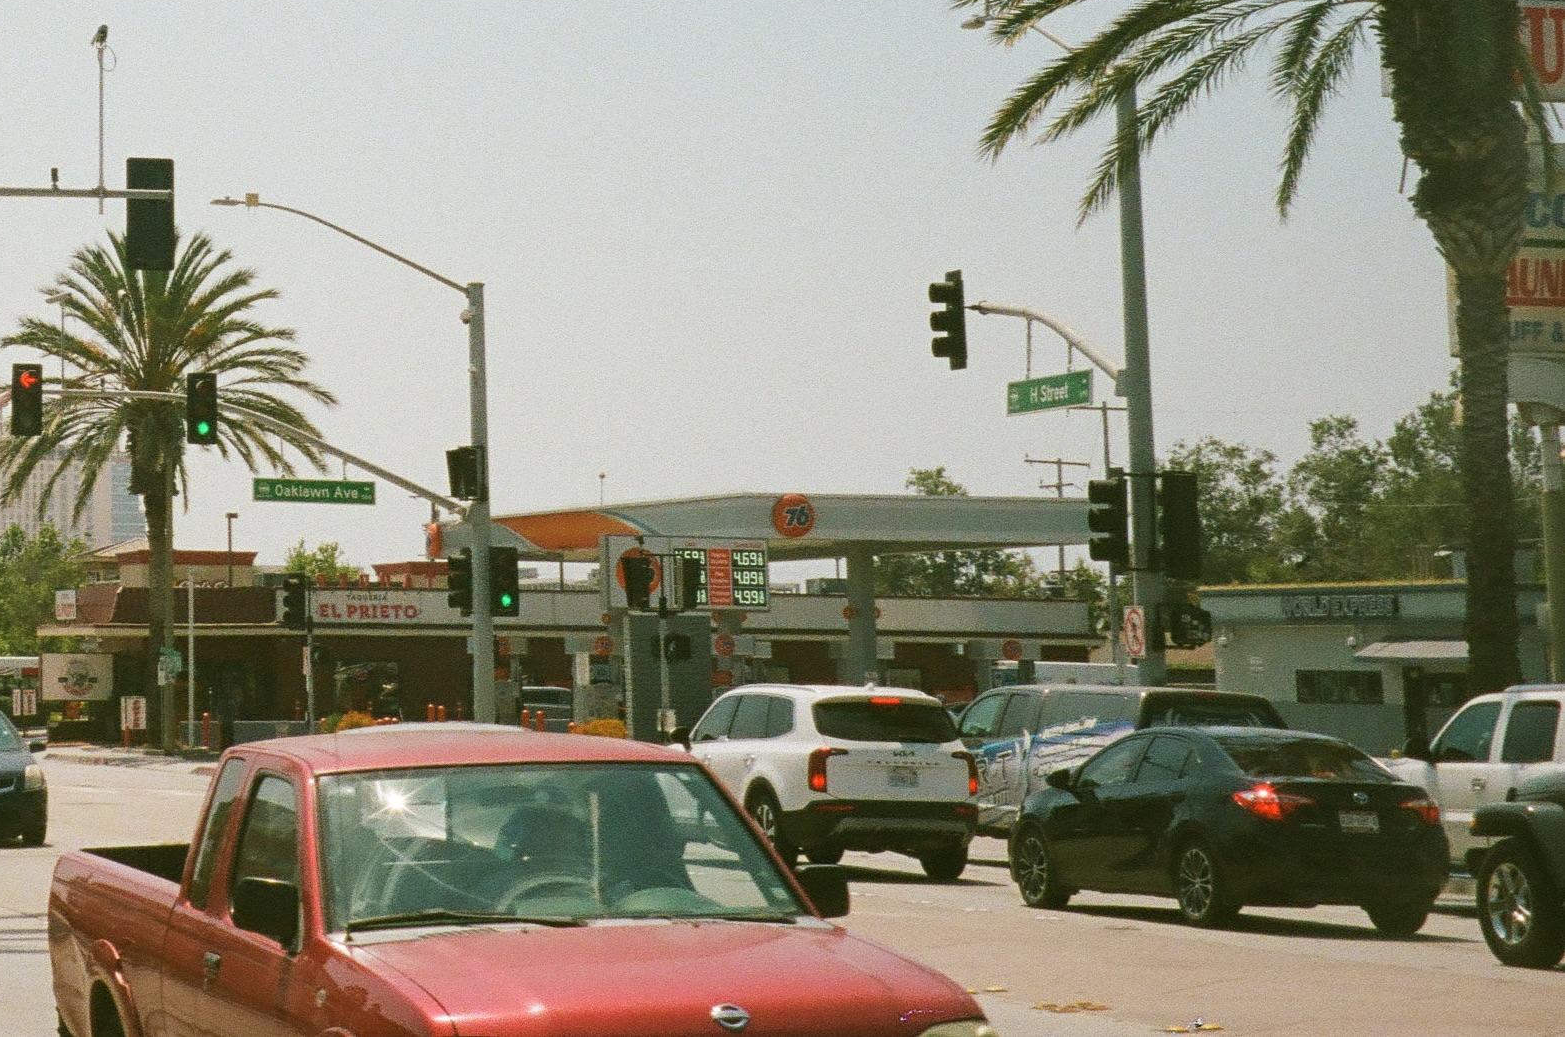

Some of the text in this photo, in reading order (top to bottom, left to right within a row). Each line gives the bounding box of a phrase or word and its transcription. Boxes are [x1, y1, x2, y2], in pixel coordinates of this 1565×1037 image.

[1029, 387, 1038, 404] H
[1040, 382, 1069, 403] Street
[274, 484, 330, 499] Oaklawn
[334, 486, 359, 500] Ave
[785, 504, 810, 528] 76
[345, 594, 388, 602] TAQUERIA
[1330, 594, 1395, 617] EXPRESS
[318, 603, 417, 620] EL PRIETO
